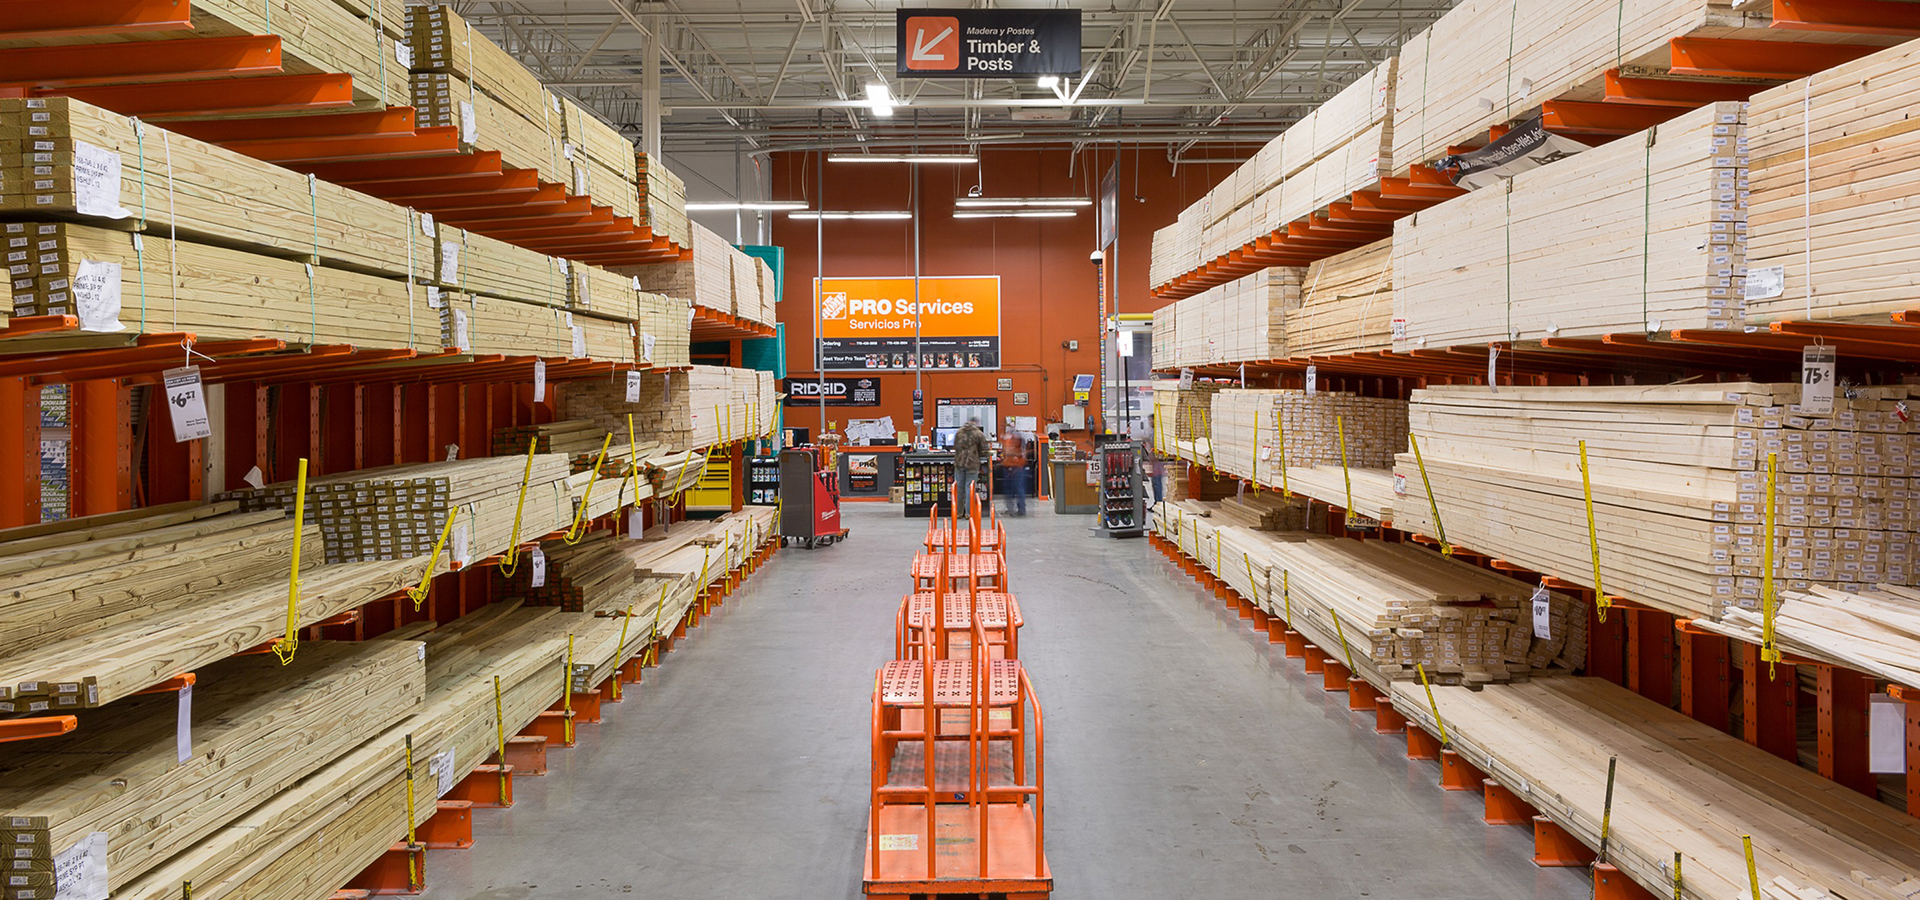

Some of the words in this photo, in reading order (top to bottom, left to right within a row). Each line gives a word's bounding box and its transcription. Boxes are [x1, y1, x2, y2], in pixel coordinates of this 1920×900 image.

[967, 26, 998, 35] Madera
[999, 28, 1005, 37] y
[1006, 26, 1035, 35] Postes
[967, 39, 1024, 54] Timber
[1029, 39, 1041, 54] &
[967, 57, 1013, 71] Posts
[1501, 133, 1534, 155] Open-Web
[849, 299, 892, 315] PRO
[895, 298, 974, 315] Services
[849, 319, 901, 330] Servicios
[903, 319, 922, 329] Pro
[791, 382, 847, 395] RIDGID
[1090, 462, 1100, 471] 15
